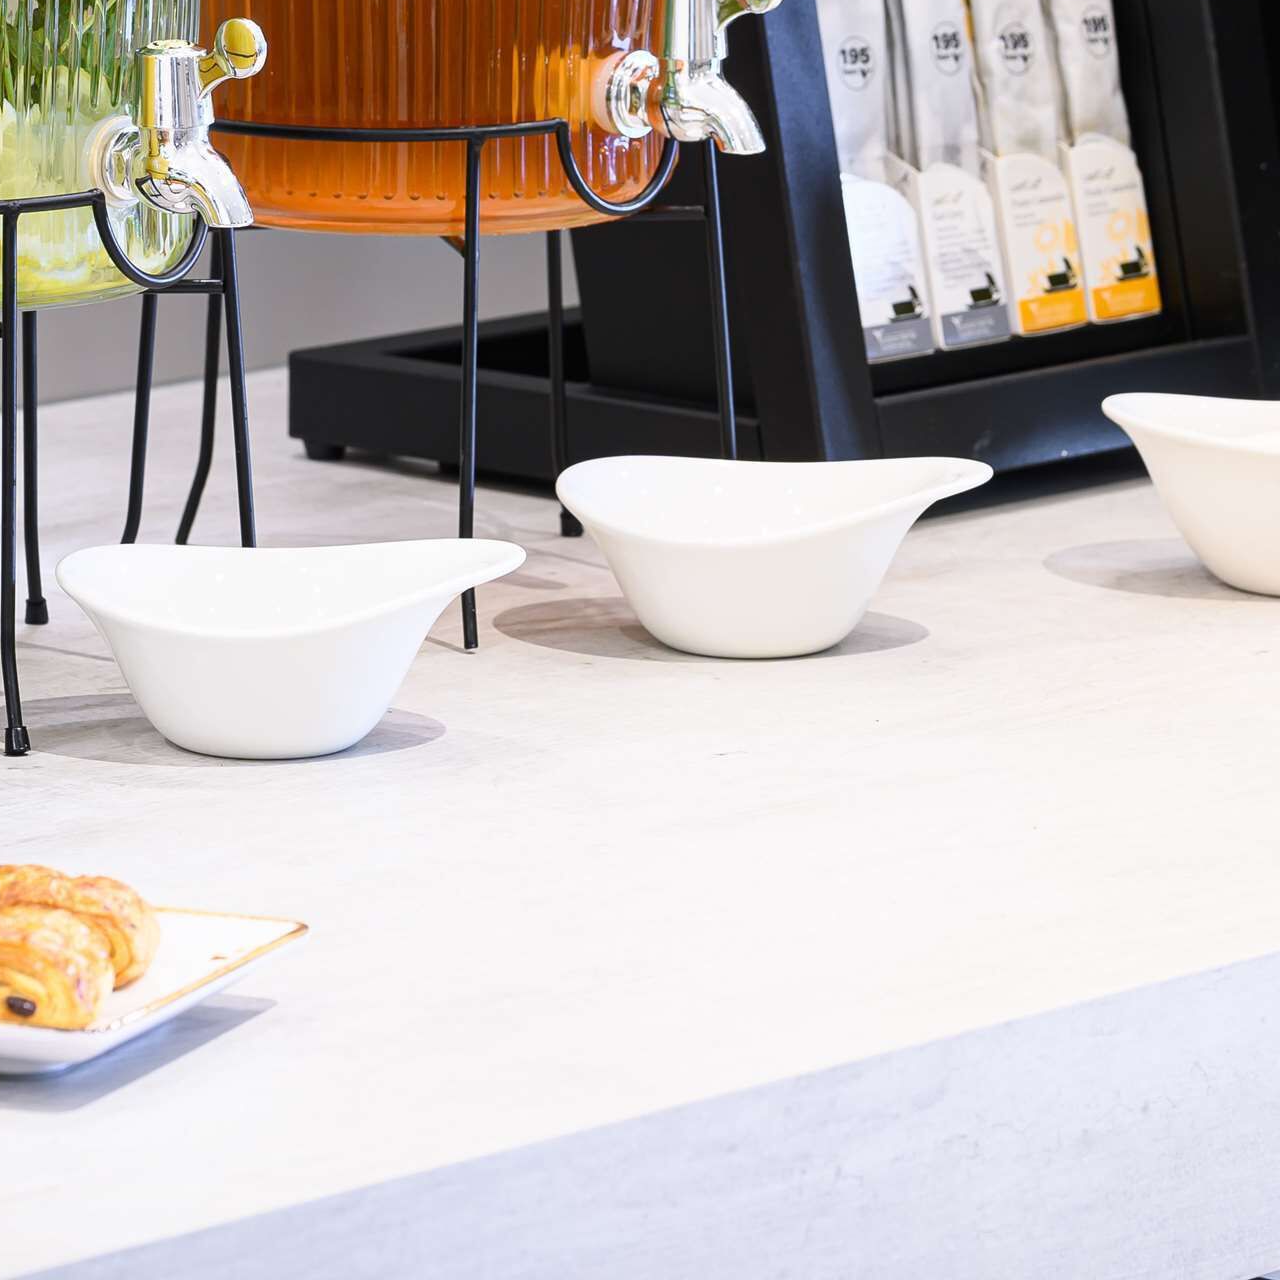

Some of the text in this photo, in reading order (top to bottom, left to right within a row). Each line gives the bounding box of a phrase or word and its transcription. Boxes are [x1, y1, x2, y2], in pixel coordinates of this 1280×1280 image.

[1081, 14, 1111, 34] 195
[931, 31, 961, 51] 195
[998, 31, 1030, 51] 195
[839, 45, 871, 66] 195
